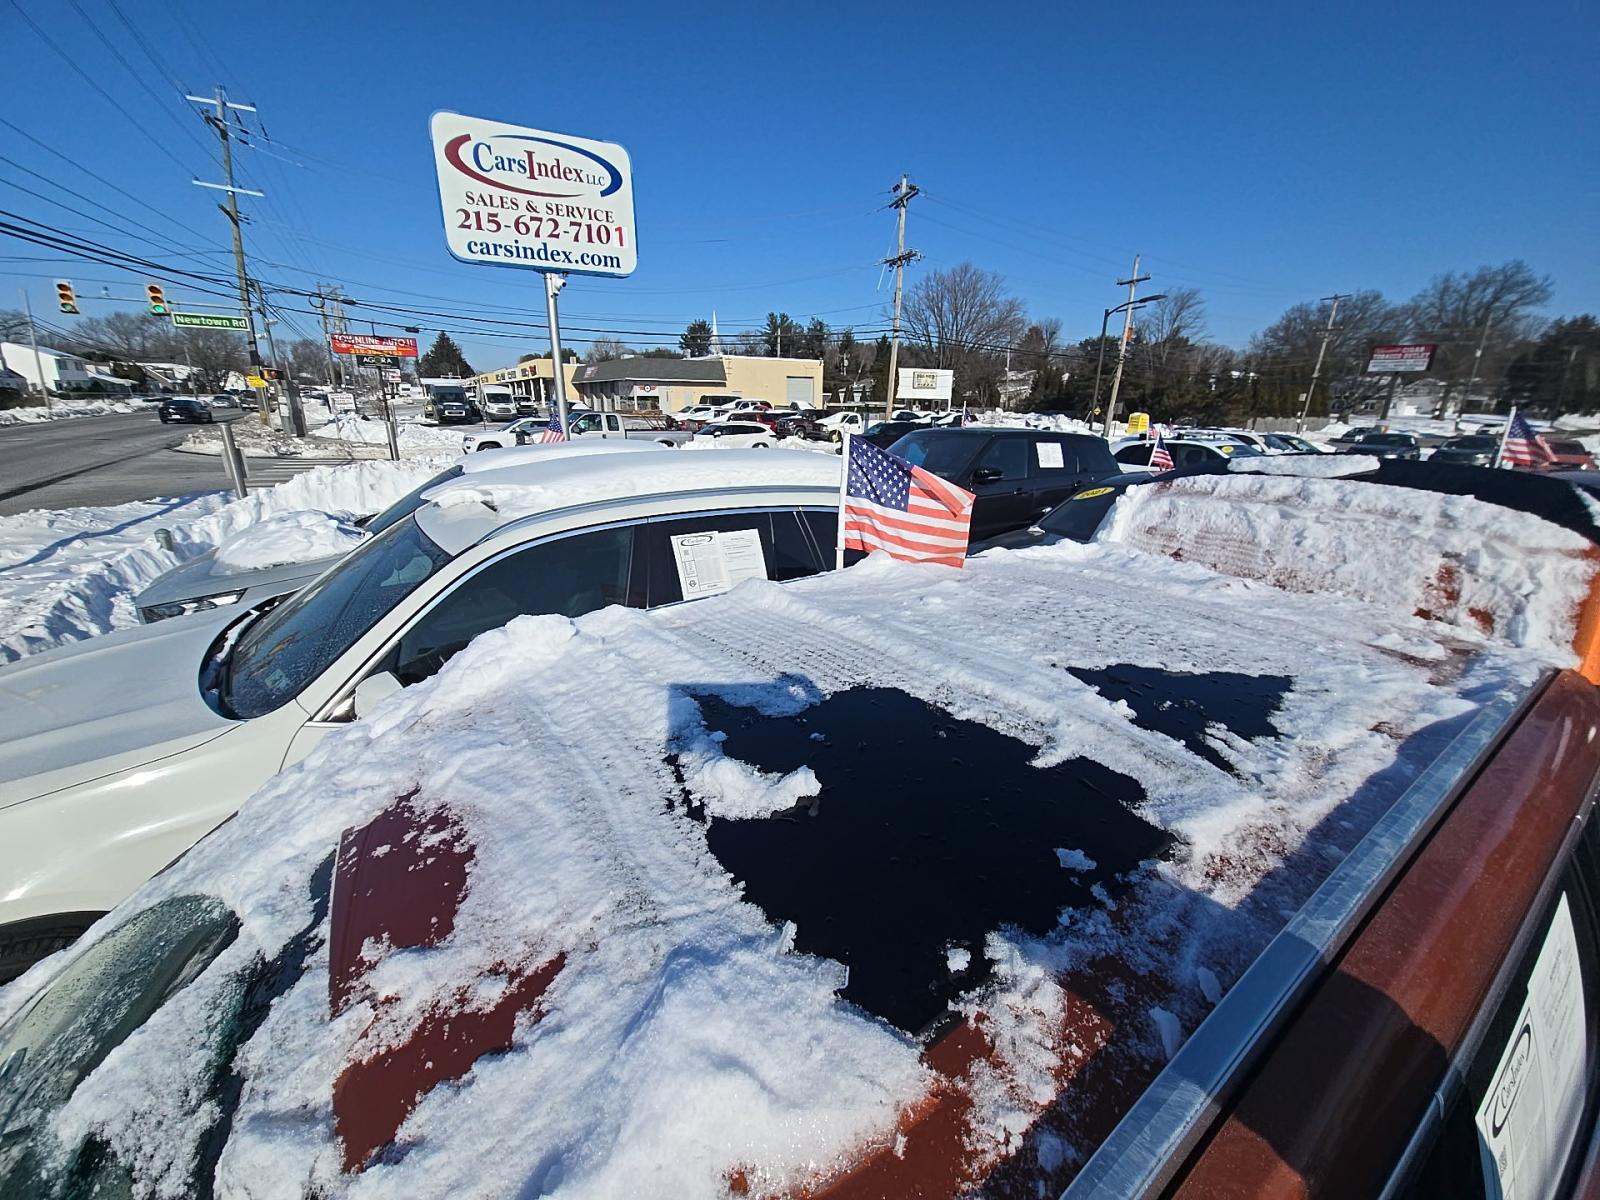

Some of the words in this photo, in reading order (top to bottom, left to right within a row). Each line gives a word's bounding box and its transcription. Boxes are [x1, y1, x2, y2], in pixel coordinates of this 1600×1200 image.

[472, 142, 584, 184] CarsIndex
[584, 173, 605, 187] LLC
[465, 190, 519, 211] SALES
[525, 199, 540, 214] &
[545, 202, 615, 224] SERVICE
[456, 208, 625, 247] 215-672-7101
[467, 239, 621, 269] carsindex.com
[175, 315, 230, 326] Newtown
[232, 319, 246, 328] Rd
